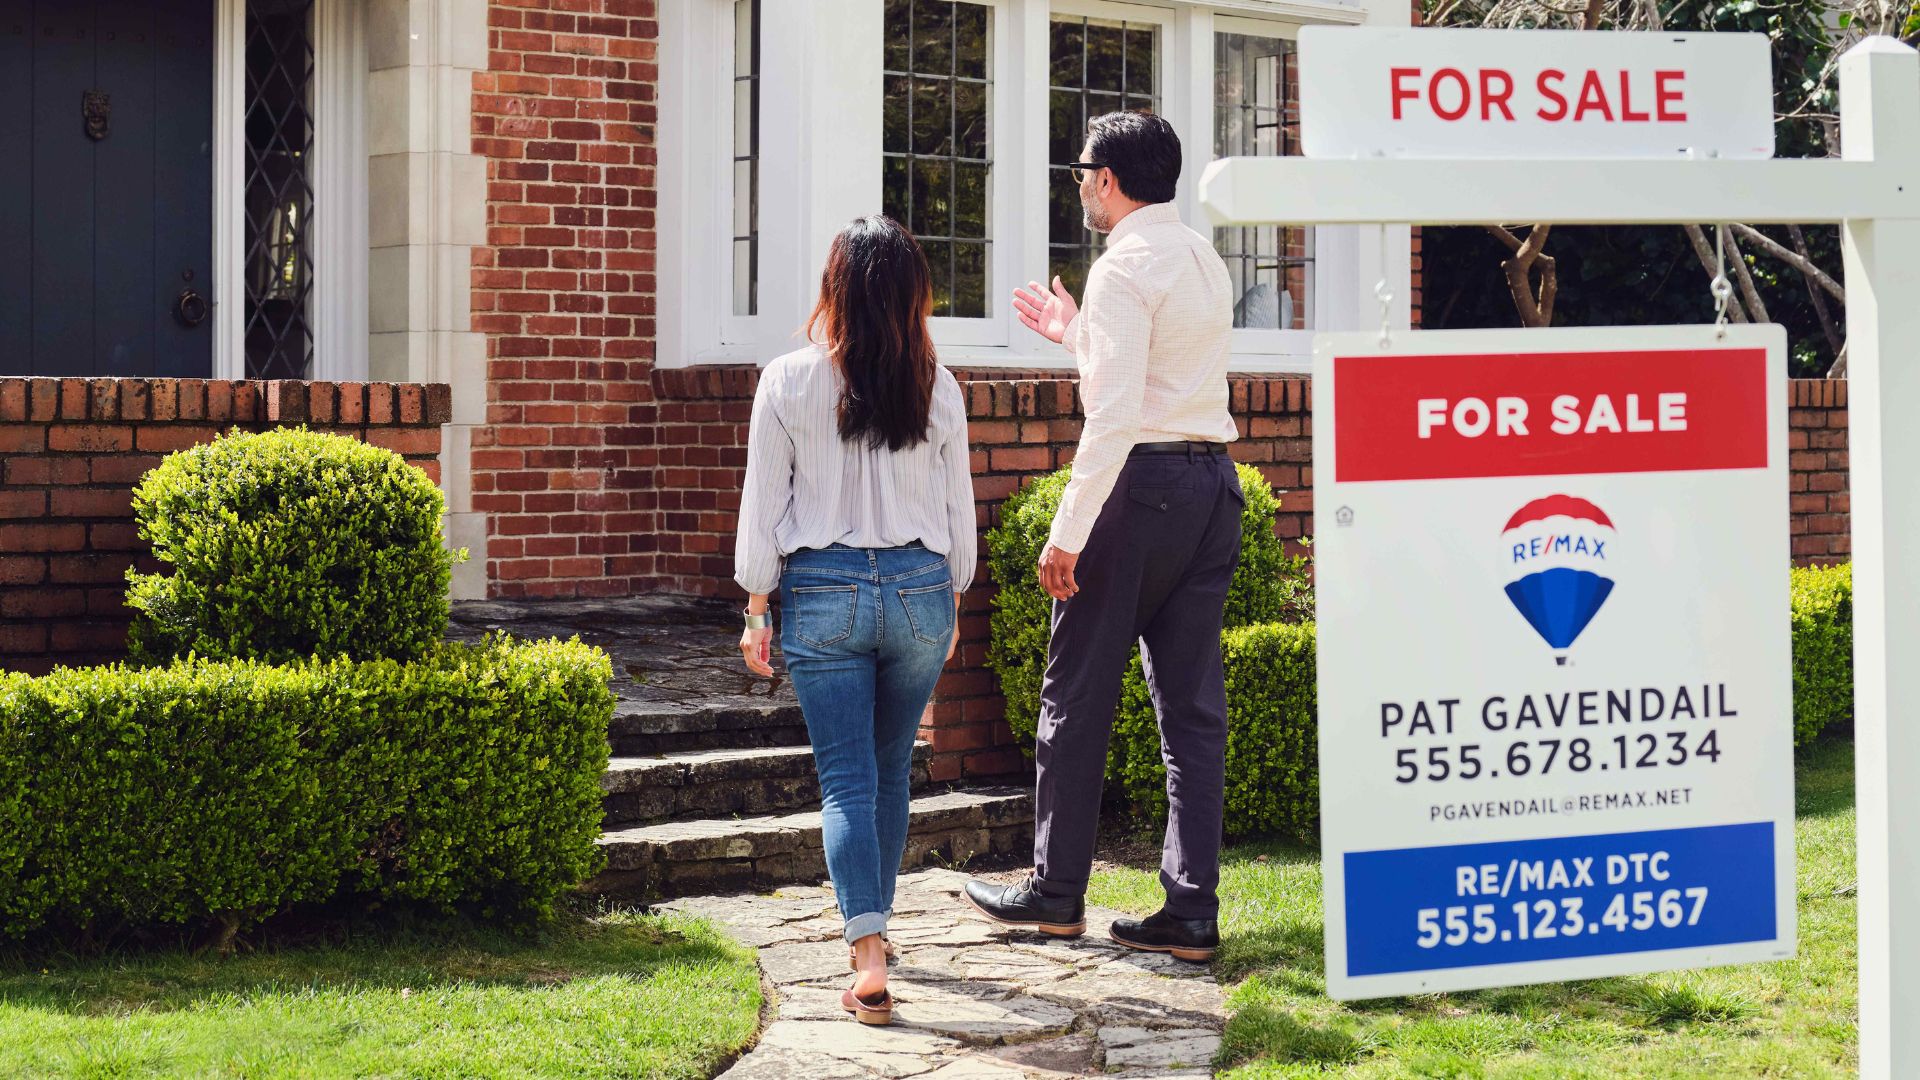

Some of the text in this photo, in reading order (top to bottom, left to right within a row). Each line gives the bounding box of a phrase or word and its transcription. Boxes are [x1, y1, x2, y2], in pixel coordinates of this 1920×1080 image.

[1389, 67, 1688, 123] FOR SALE
[1417, 392, 1688, 439] FOR SALE
[1512, 534, 1606, 564] RE/MAX
[1381, 683, 1738, 738] PAT GAVENDAIL
[1395, 729, 1722, 784] 555.678.1234
[1430, 788, 1692, 822] PGAVENDAIL@REMAX.NET
[1456, 851, 1671, 898] RE/MAX DTC
[1416, 887, 1708, 949] 555.123.4567
